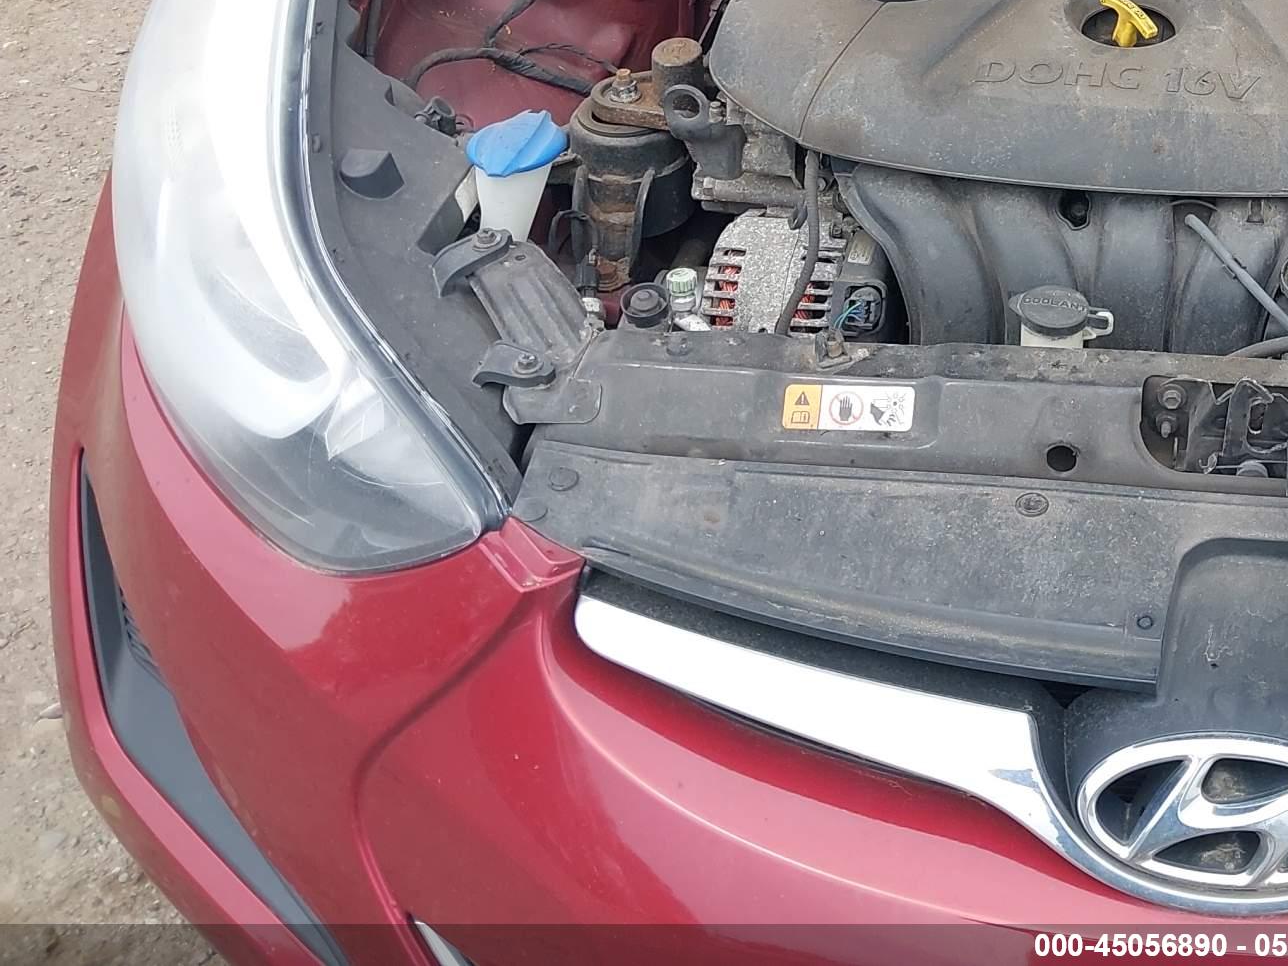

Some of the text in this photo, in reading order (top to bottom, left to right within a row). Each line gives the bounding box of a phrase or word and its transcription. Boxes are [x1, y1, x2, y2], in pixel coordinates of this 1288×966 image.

[971, 61, 1262, 100] DOHC 16V
[1023, 297, 1087, 313] COOLANT
